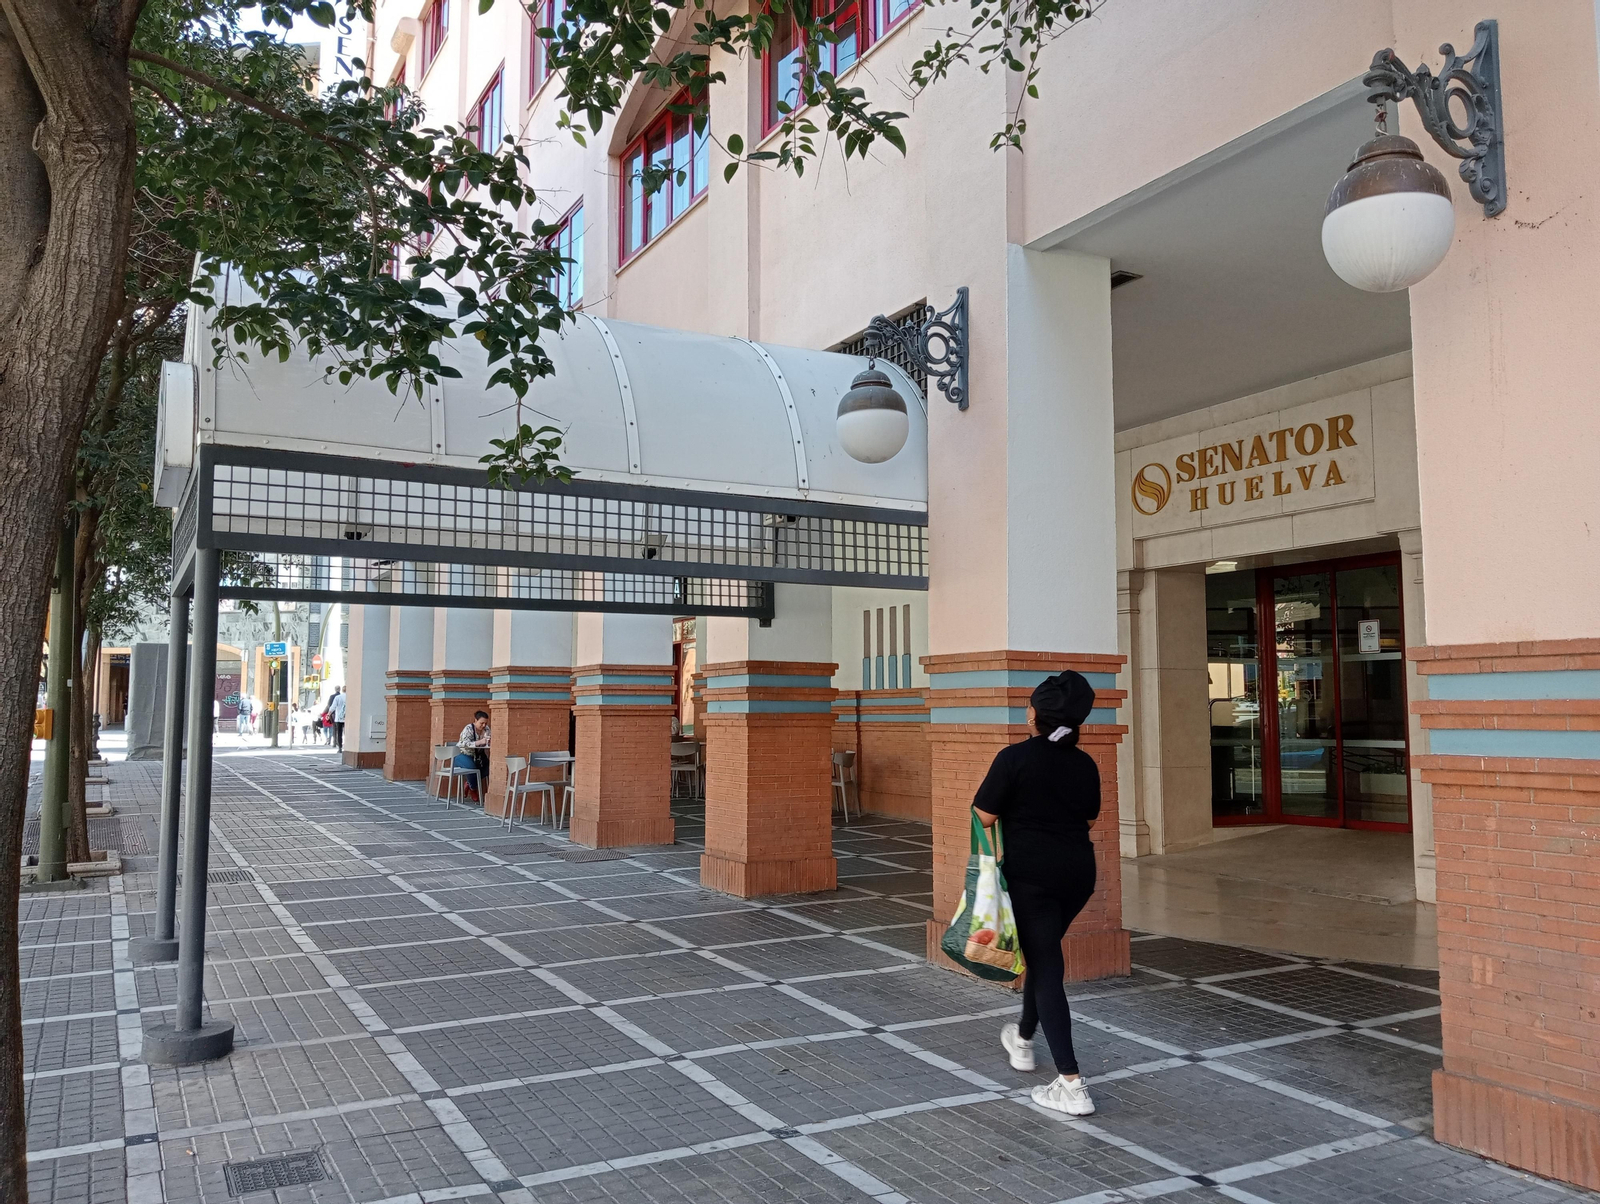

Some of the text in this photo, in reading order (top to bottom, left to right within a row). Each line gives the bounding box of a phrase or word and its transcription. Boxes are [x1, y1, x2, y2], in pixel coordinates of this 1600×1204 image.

[334, 16, 354, 98] SEN
[1175, 414, 1357, 484] SENATOR
[1189, 460, 1346, 512] HUELVA
